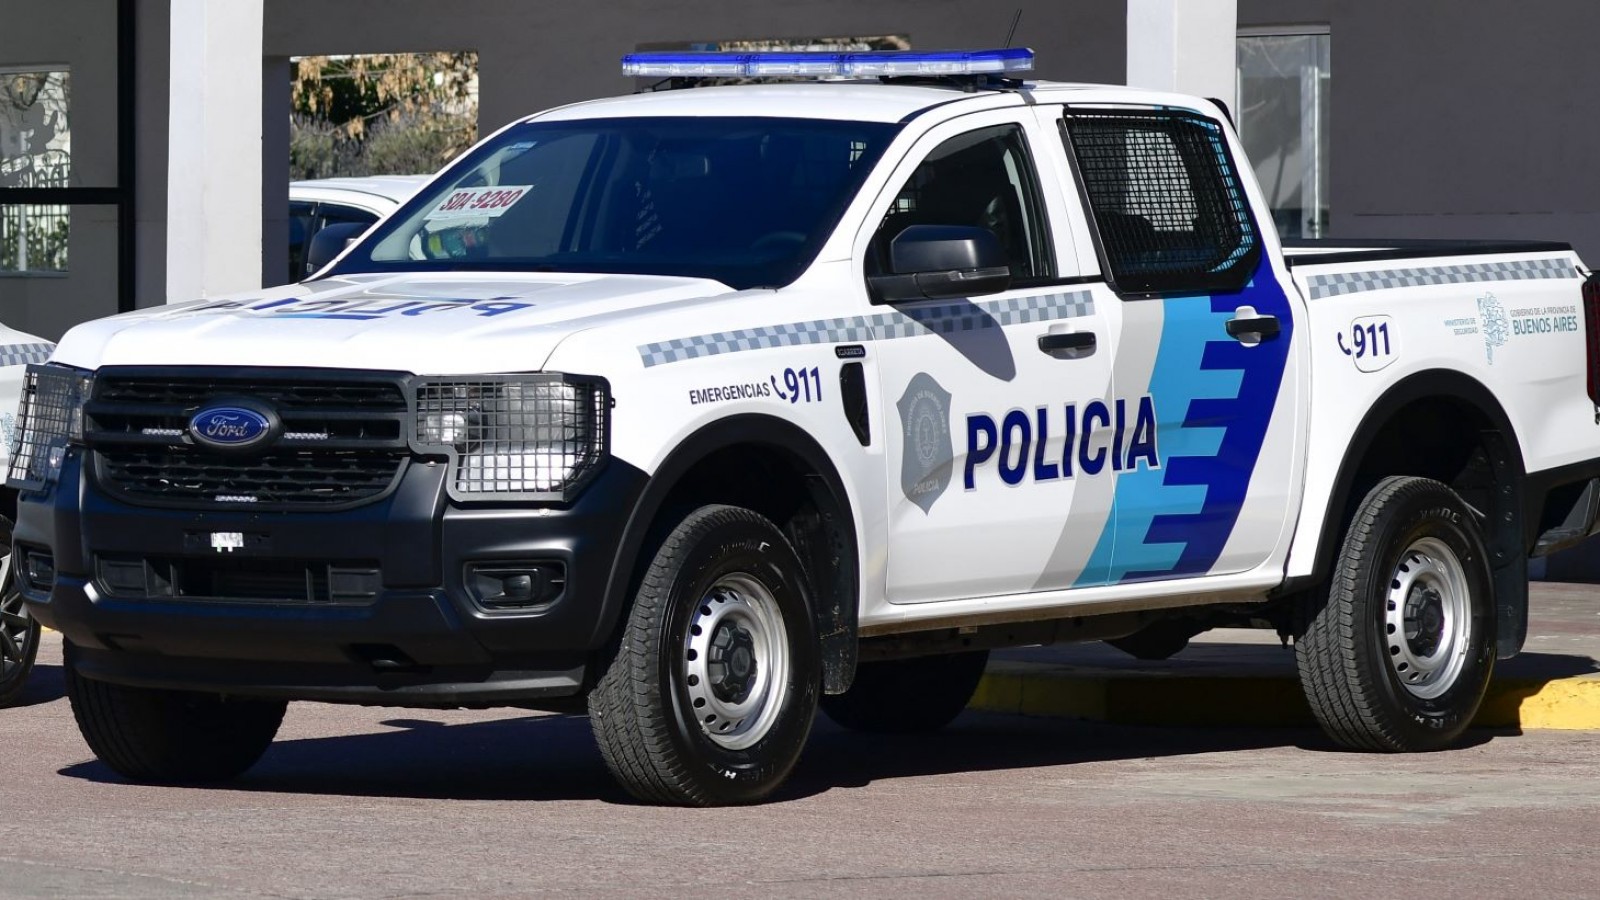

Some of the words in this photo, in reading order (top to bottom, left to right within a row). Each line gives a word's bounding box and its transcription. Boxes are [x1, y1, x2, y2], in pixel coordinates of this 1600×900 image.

[1353, 321, 1390, 359] 911
[1512, 318, 1551, 335] BUENOS
[1553, 316, 1577, 332] AIRES
[689, 382, 770, 405] EMERGENCIAS
[783, 366, 822, 404] 911
[206, 414, 249, 437] Ford
[964, 395, 1160, 490] POLICIA
